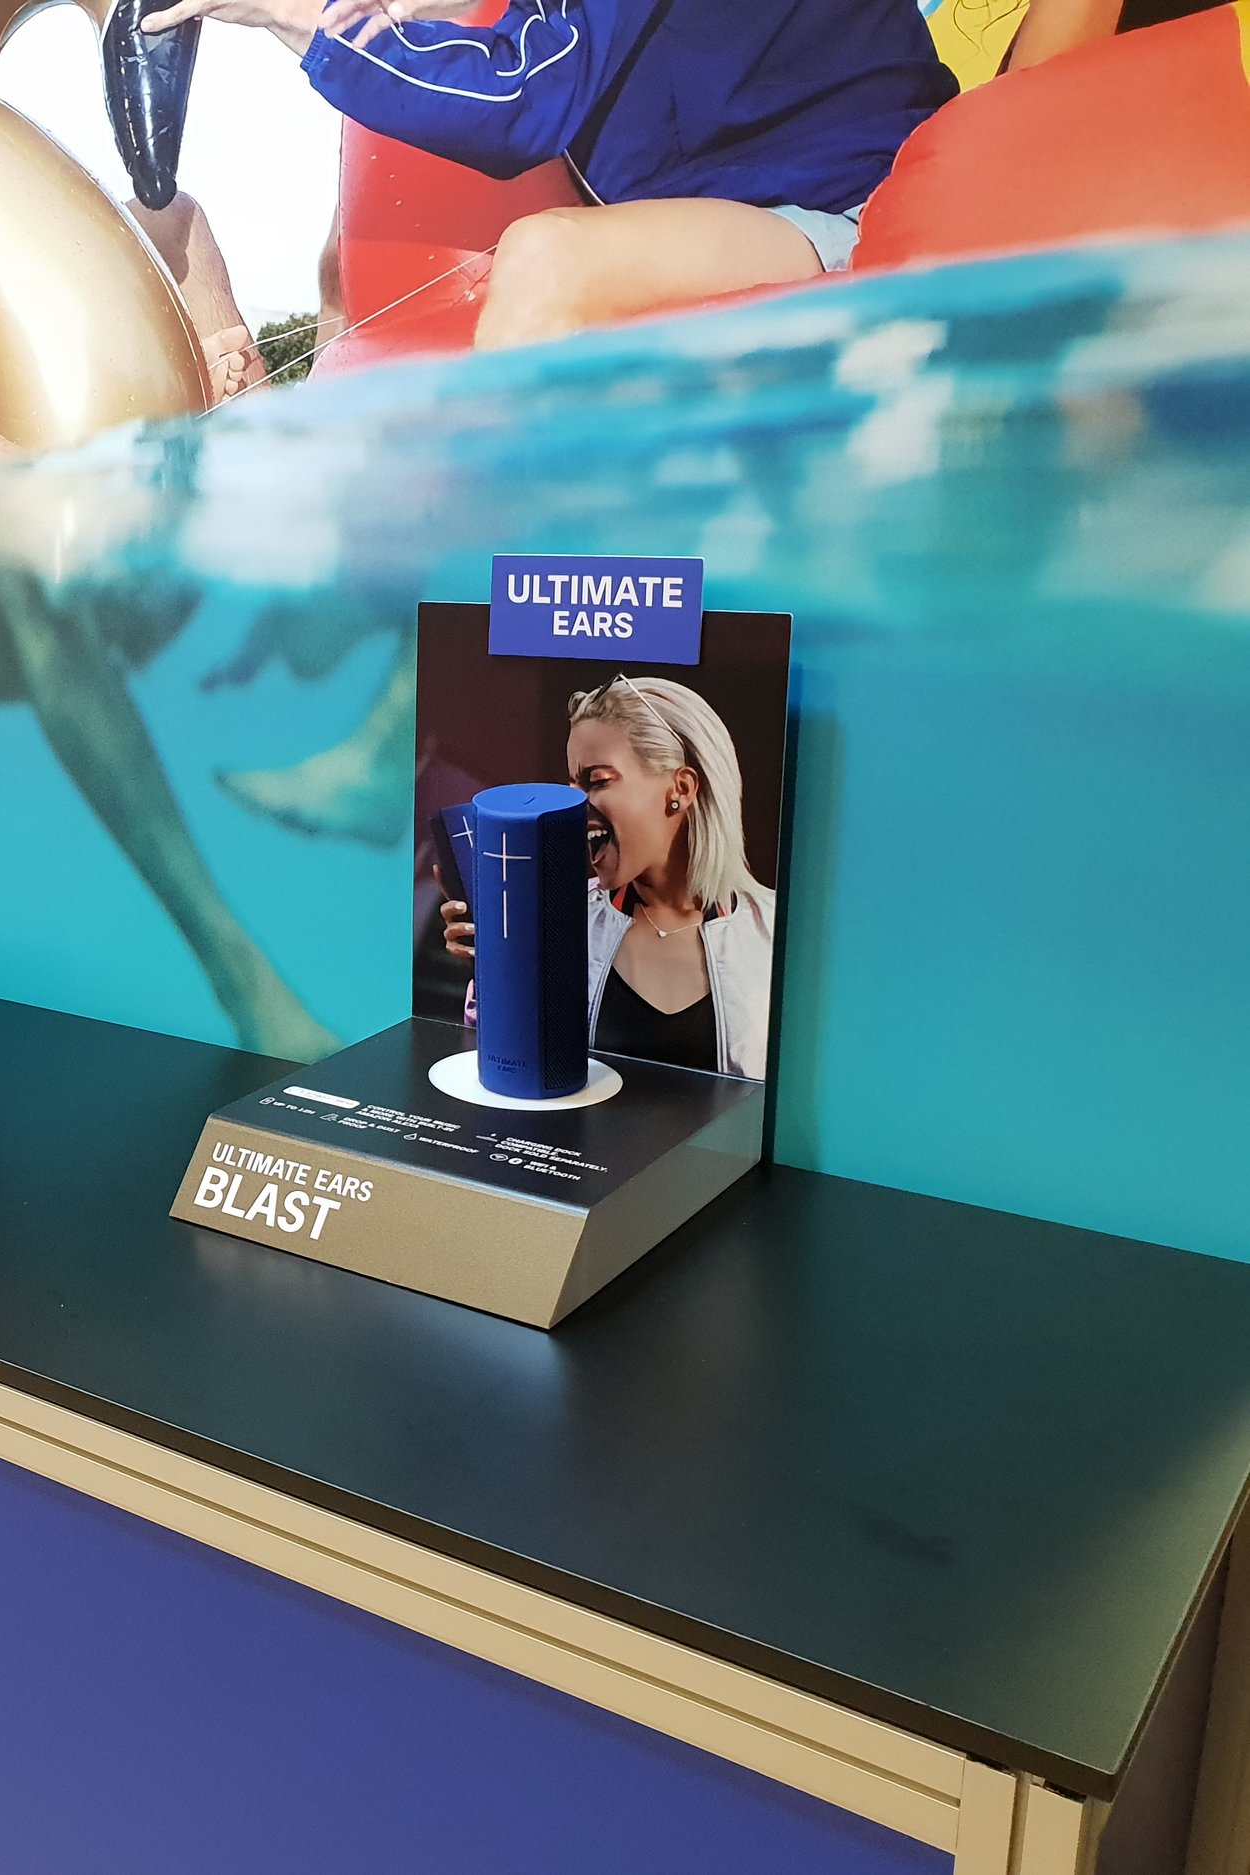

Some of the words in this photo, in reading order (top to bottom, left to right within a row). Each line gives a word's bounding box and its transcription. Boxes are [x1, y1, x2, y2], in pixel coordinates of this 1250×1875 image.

[507, 574, 684, 608] ULTIMATE
[552, 610, 634, 638] EARS
[337, 1119, 368, 1129] PROOF
[342, 1116, 368, 1125] DROP
[375, 1125, 401, 1133] DUST
[354, 1110, 393, 1122] AMAZON
[391, 1119, 420, 1129] ALEXA
[367, 1104, 406, 1117] CONTROL
[409, 1114, 433, 1122] YOUR
[433, 1120, 462, 1130] MUSIC
[369, 1109, 396, 1118] MORE
[395, 1115, 419, 1124] WITH
[418, 1136, 480, 1154] WATERPROOF
[494, 1143, 522, 1153] DOCK
[522, 1150, 548, 1159] SOLD
[506, 1137, 554, 1150] CHARGING
[554, 1147, 582, 1157] DOCK
[211, 1141, 312, 1185] ULTIMATE
[313, 1169, 374, 1202] EARS
[523, 1164, 582, 1180] BLUETOOTH
[193, 1165, 342, 1240] BLAST
